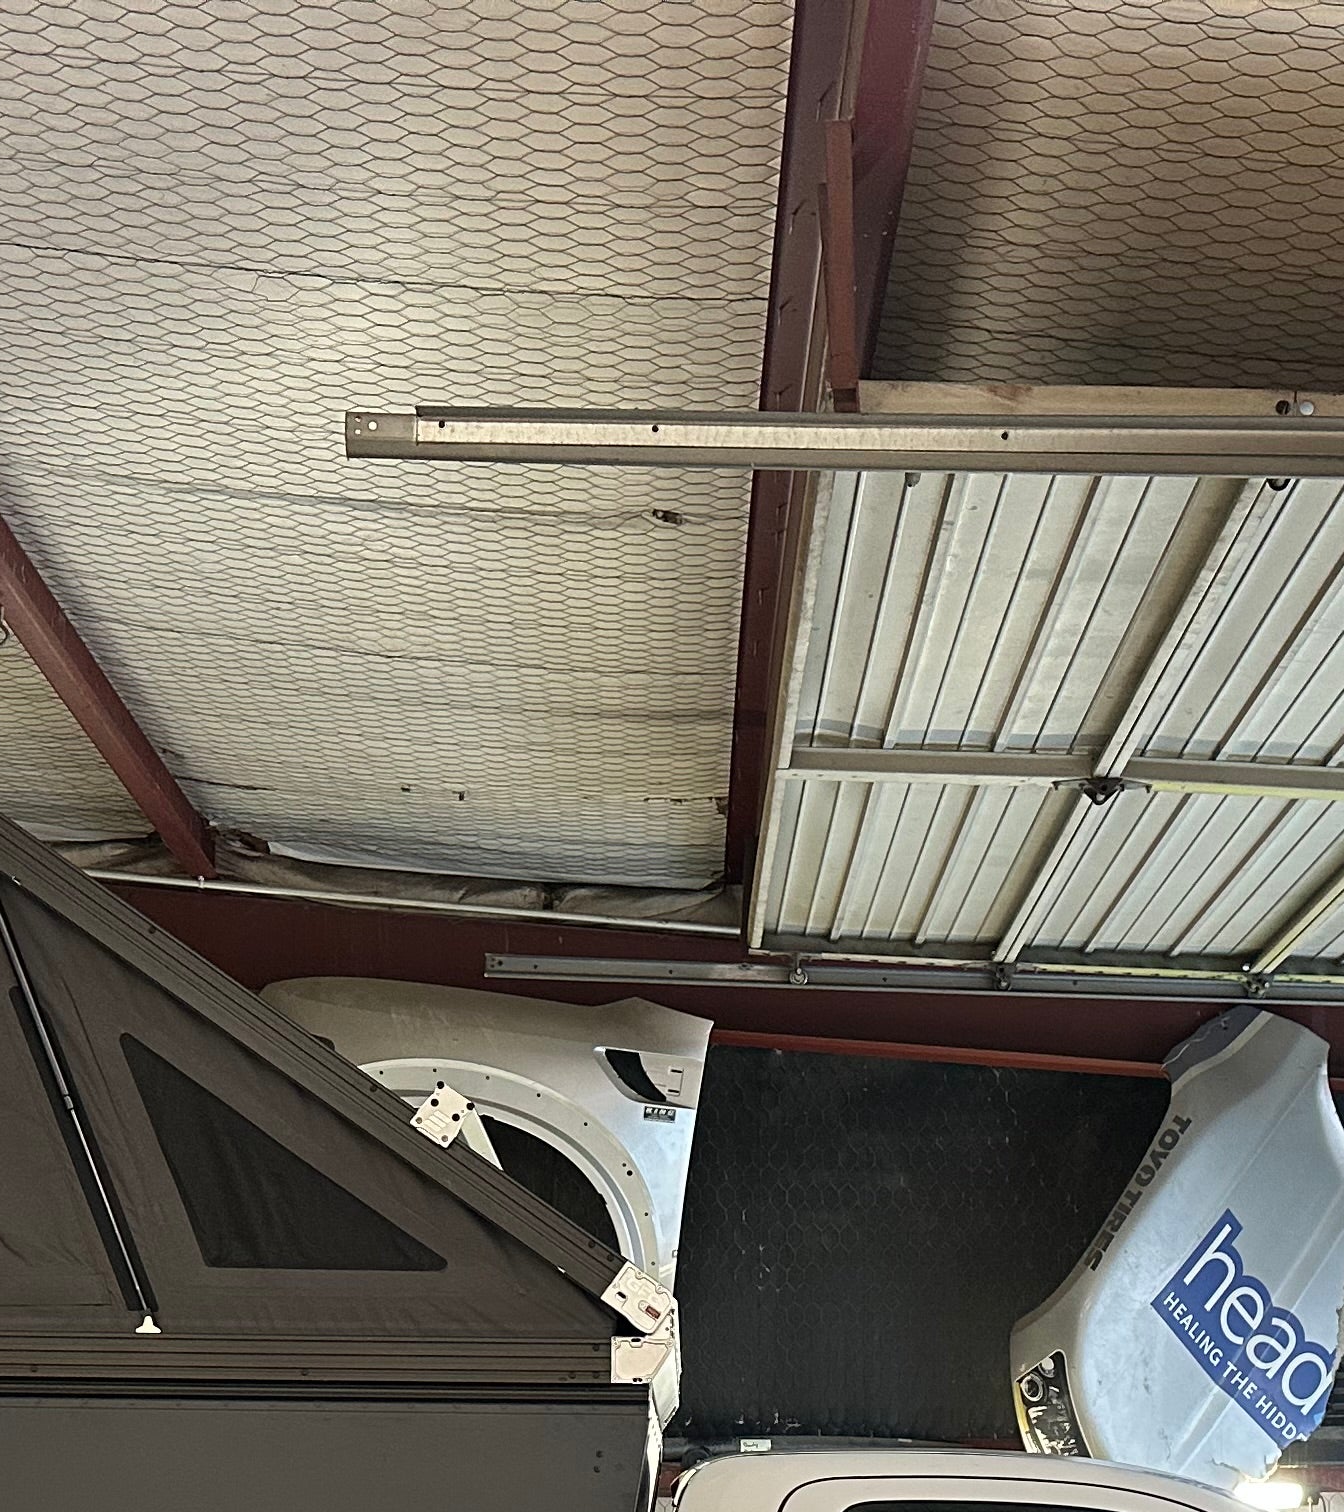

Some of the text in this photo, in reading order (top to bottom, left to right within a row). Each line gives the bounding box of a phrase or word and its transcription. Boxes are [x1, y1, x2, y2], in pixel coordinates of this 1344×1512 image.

[1135, 1115, 1192, 1187] TOYO
[1163, 1291, 1224, 1366] HEALING
[1220, 1361, 1258, 1399] THE
